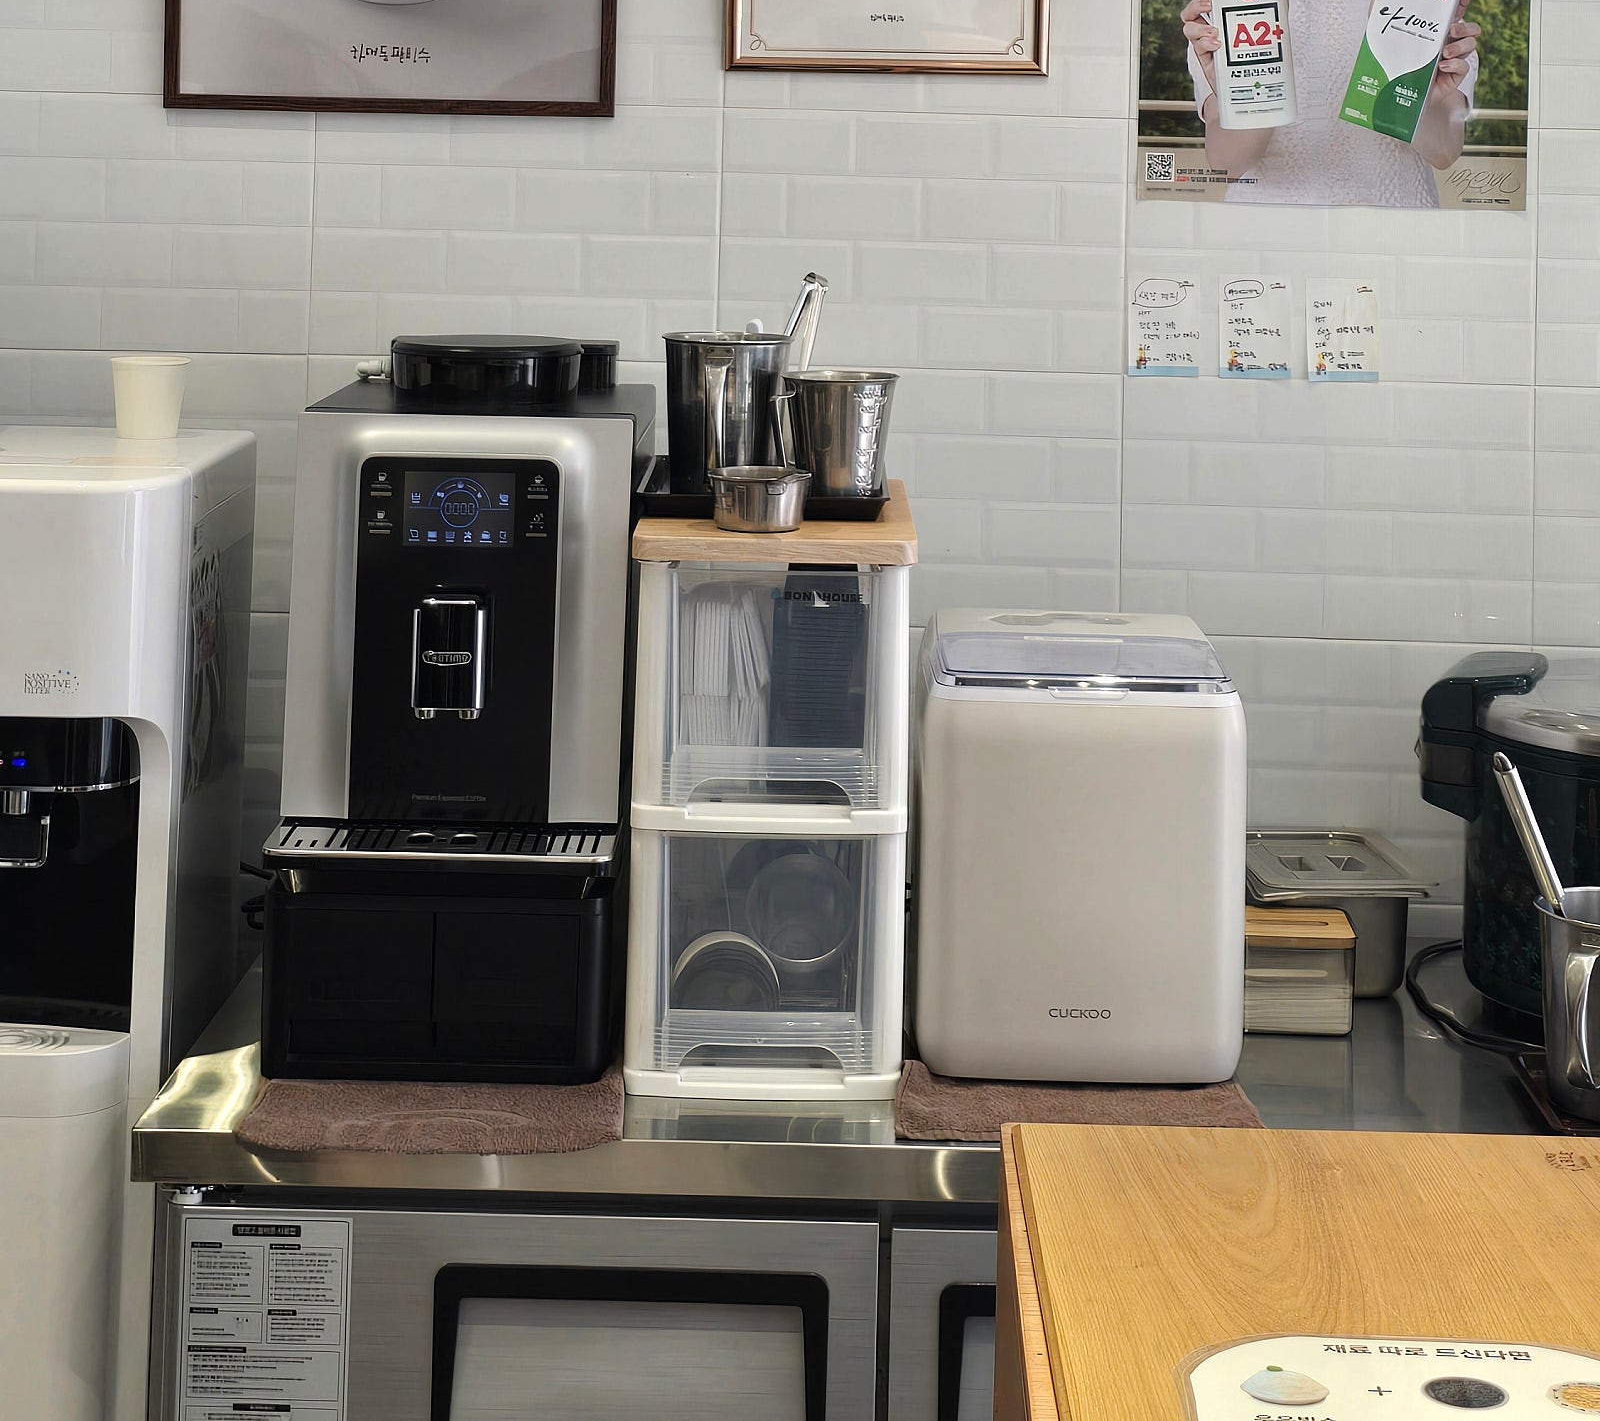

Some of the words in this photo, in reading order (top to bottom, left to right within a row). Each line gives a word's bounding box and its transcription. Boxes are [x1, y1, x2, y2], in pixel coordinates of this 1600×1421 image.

[1232, 20, 1285, 48] A2+
[1048, 1008, 1111, 1019] CUCKOO
[1322, 1343, 1373, 1355] 재료
[1378, 1345, 1429, 1357] 따로
[1435, 1347, 1533, 1362] 드신다면
